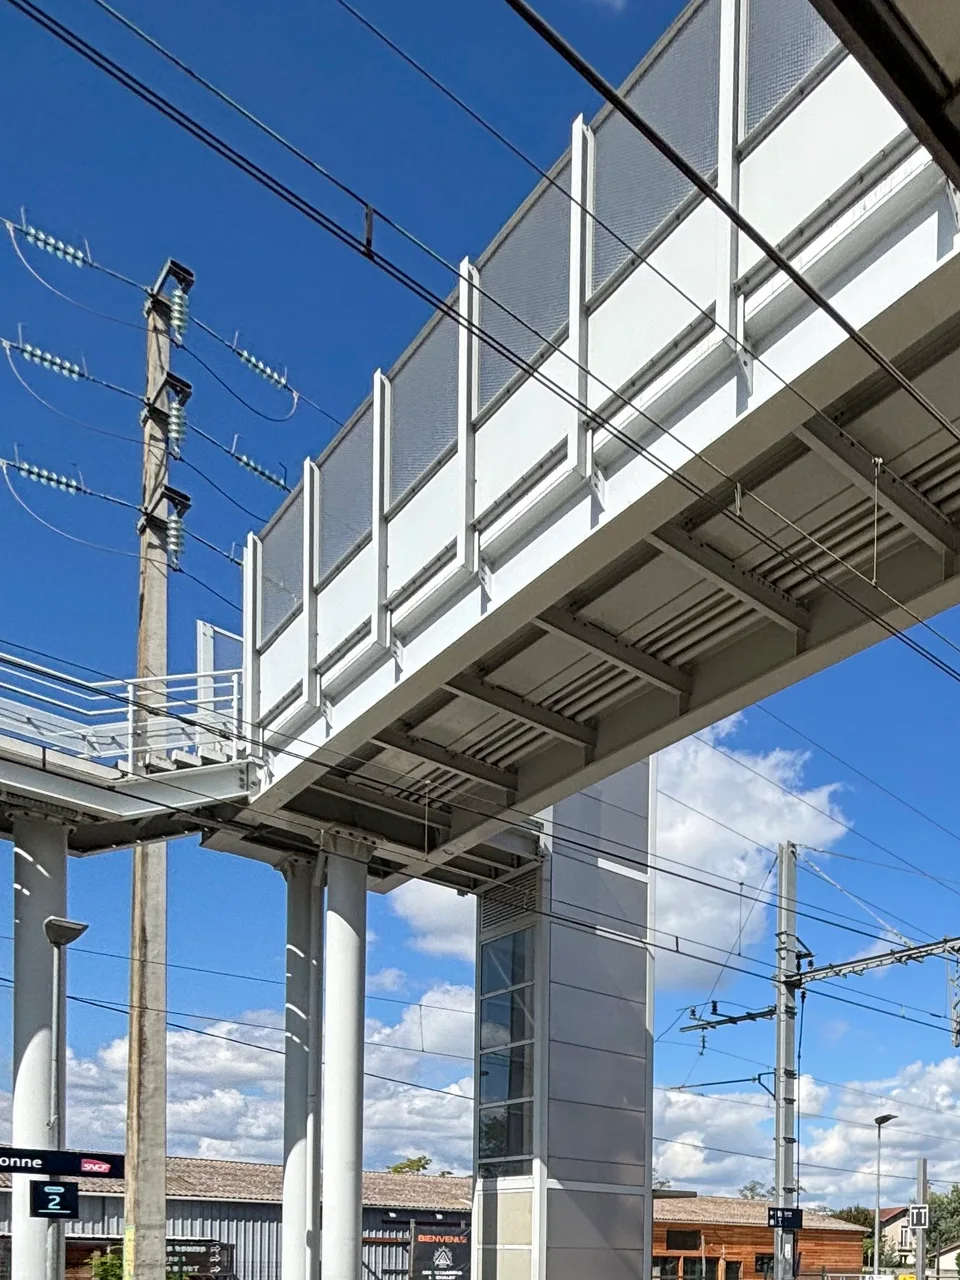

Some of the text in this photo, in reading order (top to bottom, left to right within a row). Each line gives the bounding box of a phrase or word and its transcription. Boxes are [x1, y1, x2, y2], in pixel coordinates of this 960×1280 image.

[0, 1157, 42, 1168] onne
[83, 1163, 108, 1172] SNCF
[48, 1195, 61, 1209] 2
